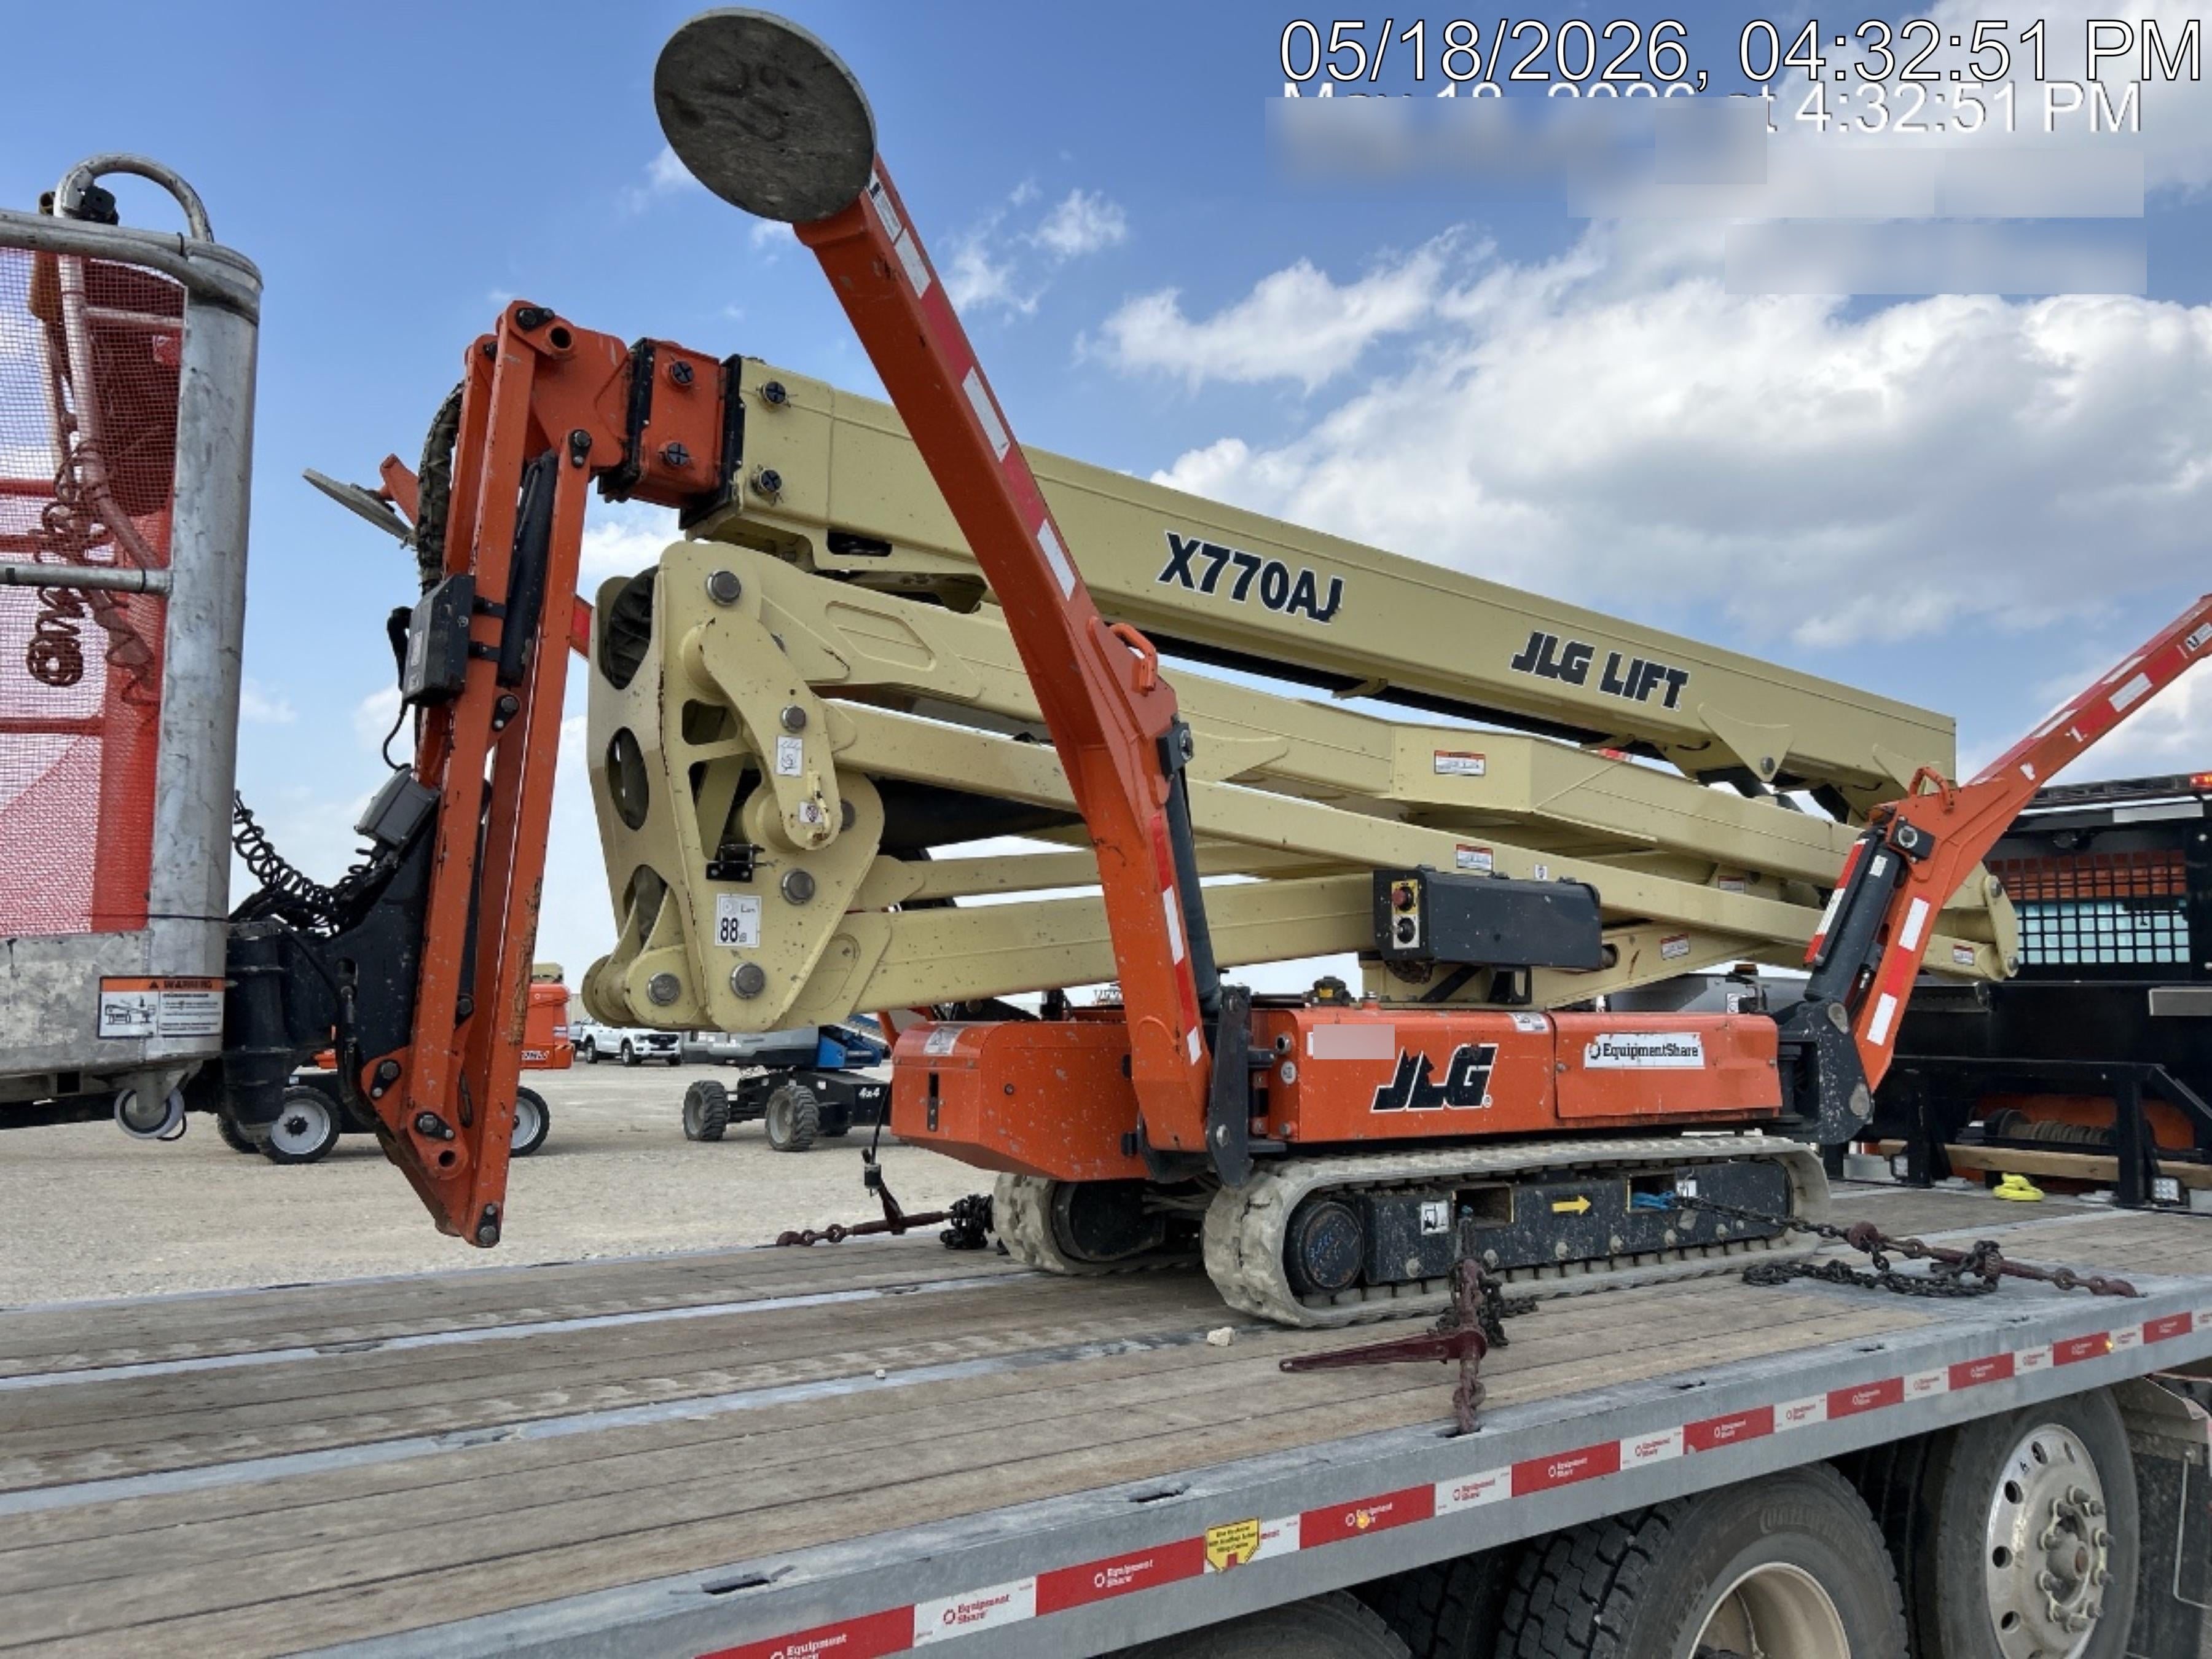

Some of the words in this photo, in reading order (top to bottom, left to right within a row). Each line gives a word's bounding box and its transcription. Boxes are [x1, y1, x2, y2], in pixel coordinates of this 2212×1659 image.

[1156, 530, 1345, 625] X770AJ
[1510, 630, 1596, 688] JLG
[1599, 650, 1690, 710] LIFT
[720, 917, 739, 942] 88
[1602, 1043, 1699, 1061] EquipmentShare
[1370, 1043, 1499, 1113] JLG
[786, 1633, 847, 1657] Equipment
